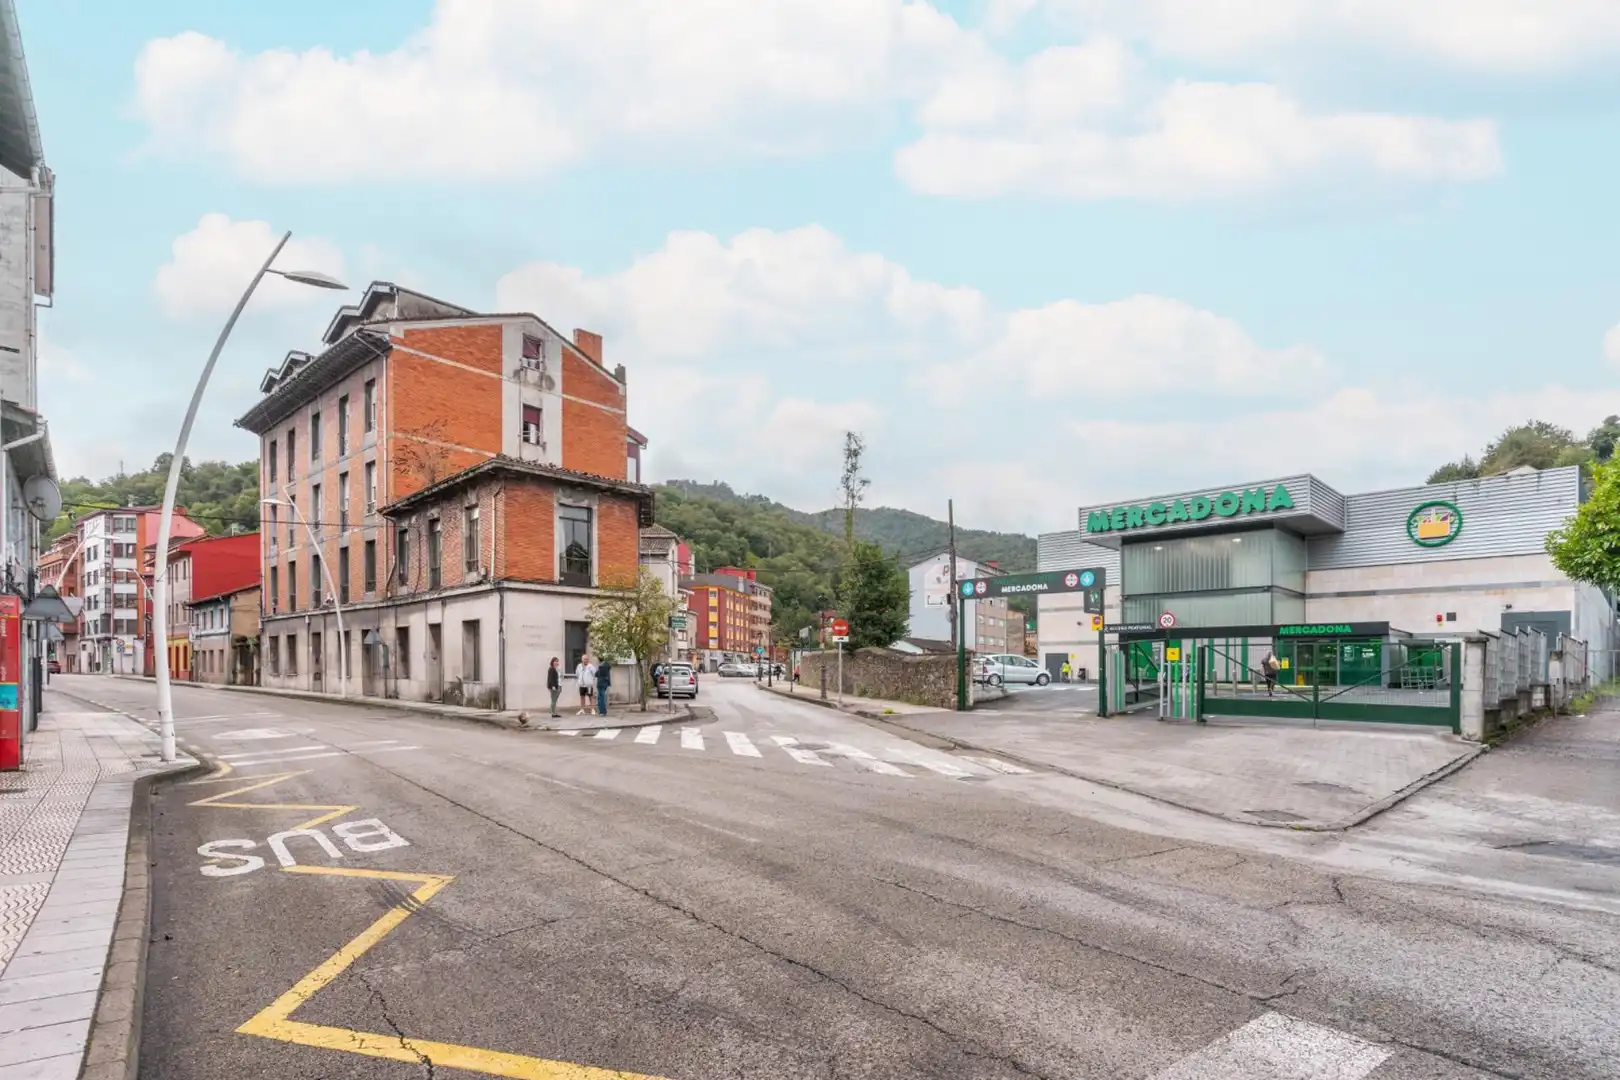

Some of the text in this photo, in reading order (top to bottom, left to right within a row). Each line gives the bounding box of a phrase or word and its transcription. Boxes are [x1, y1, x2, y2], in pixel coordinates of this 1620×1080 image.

[1087, 484, 1295, 532] MERCADONA
[1001, 583, 1048, 593] MERCADONA
[1163, 616, 1172, 624] 20
[1280, 625, 1352, 635] MERCADONA
[196, 818, 411, 877] BUS
